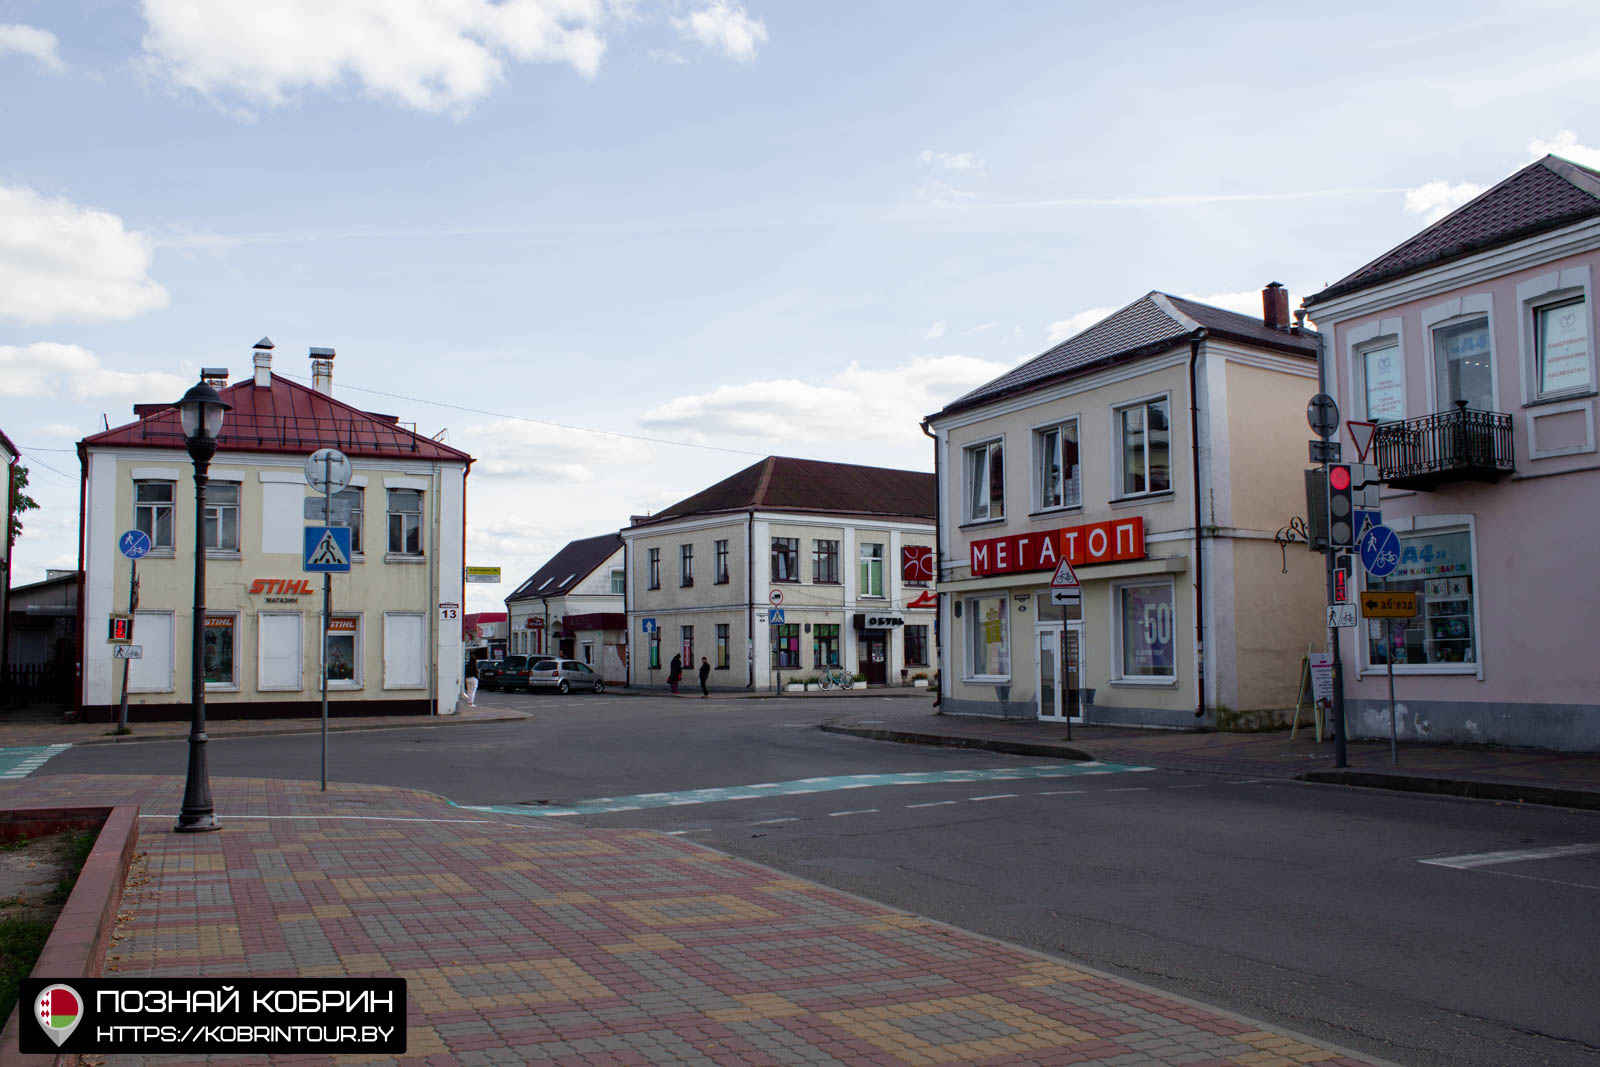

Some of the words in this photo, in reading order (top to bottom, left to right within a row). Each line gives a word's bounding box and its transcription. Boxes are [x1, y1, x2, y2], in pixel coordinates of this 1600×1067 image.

[974, 523, 1134, 571] МЕГАТОП
[249, 579, 313, 594] STIHL
[442, 610, 457, 619] 13
[869, 617, 904, 626] ОБУВЬ
